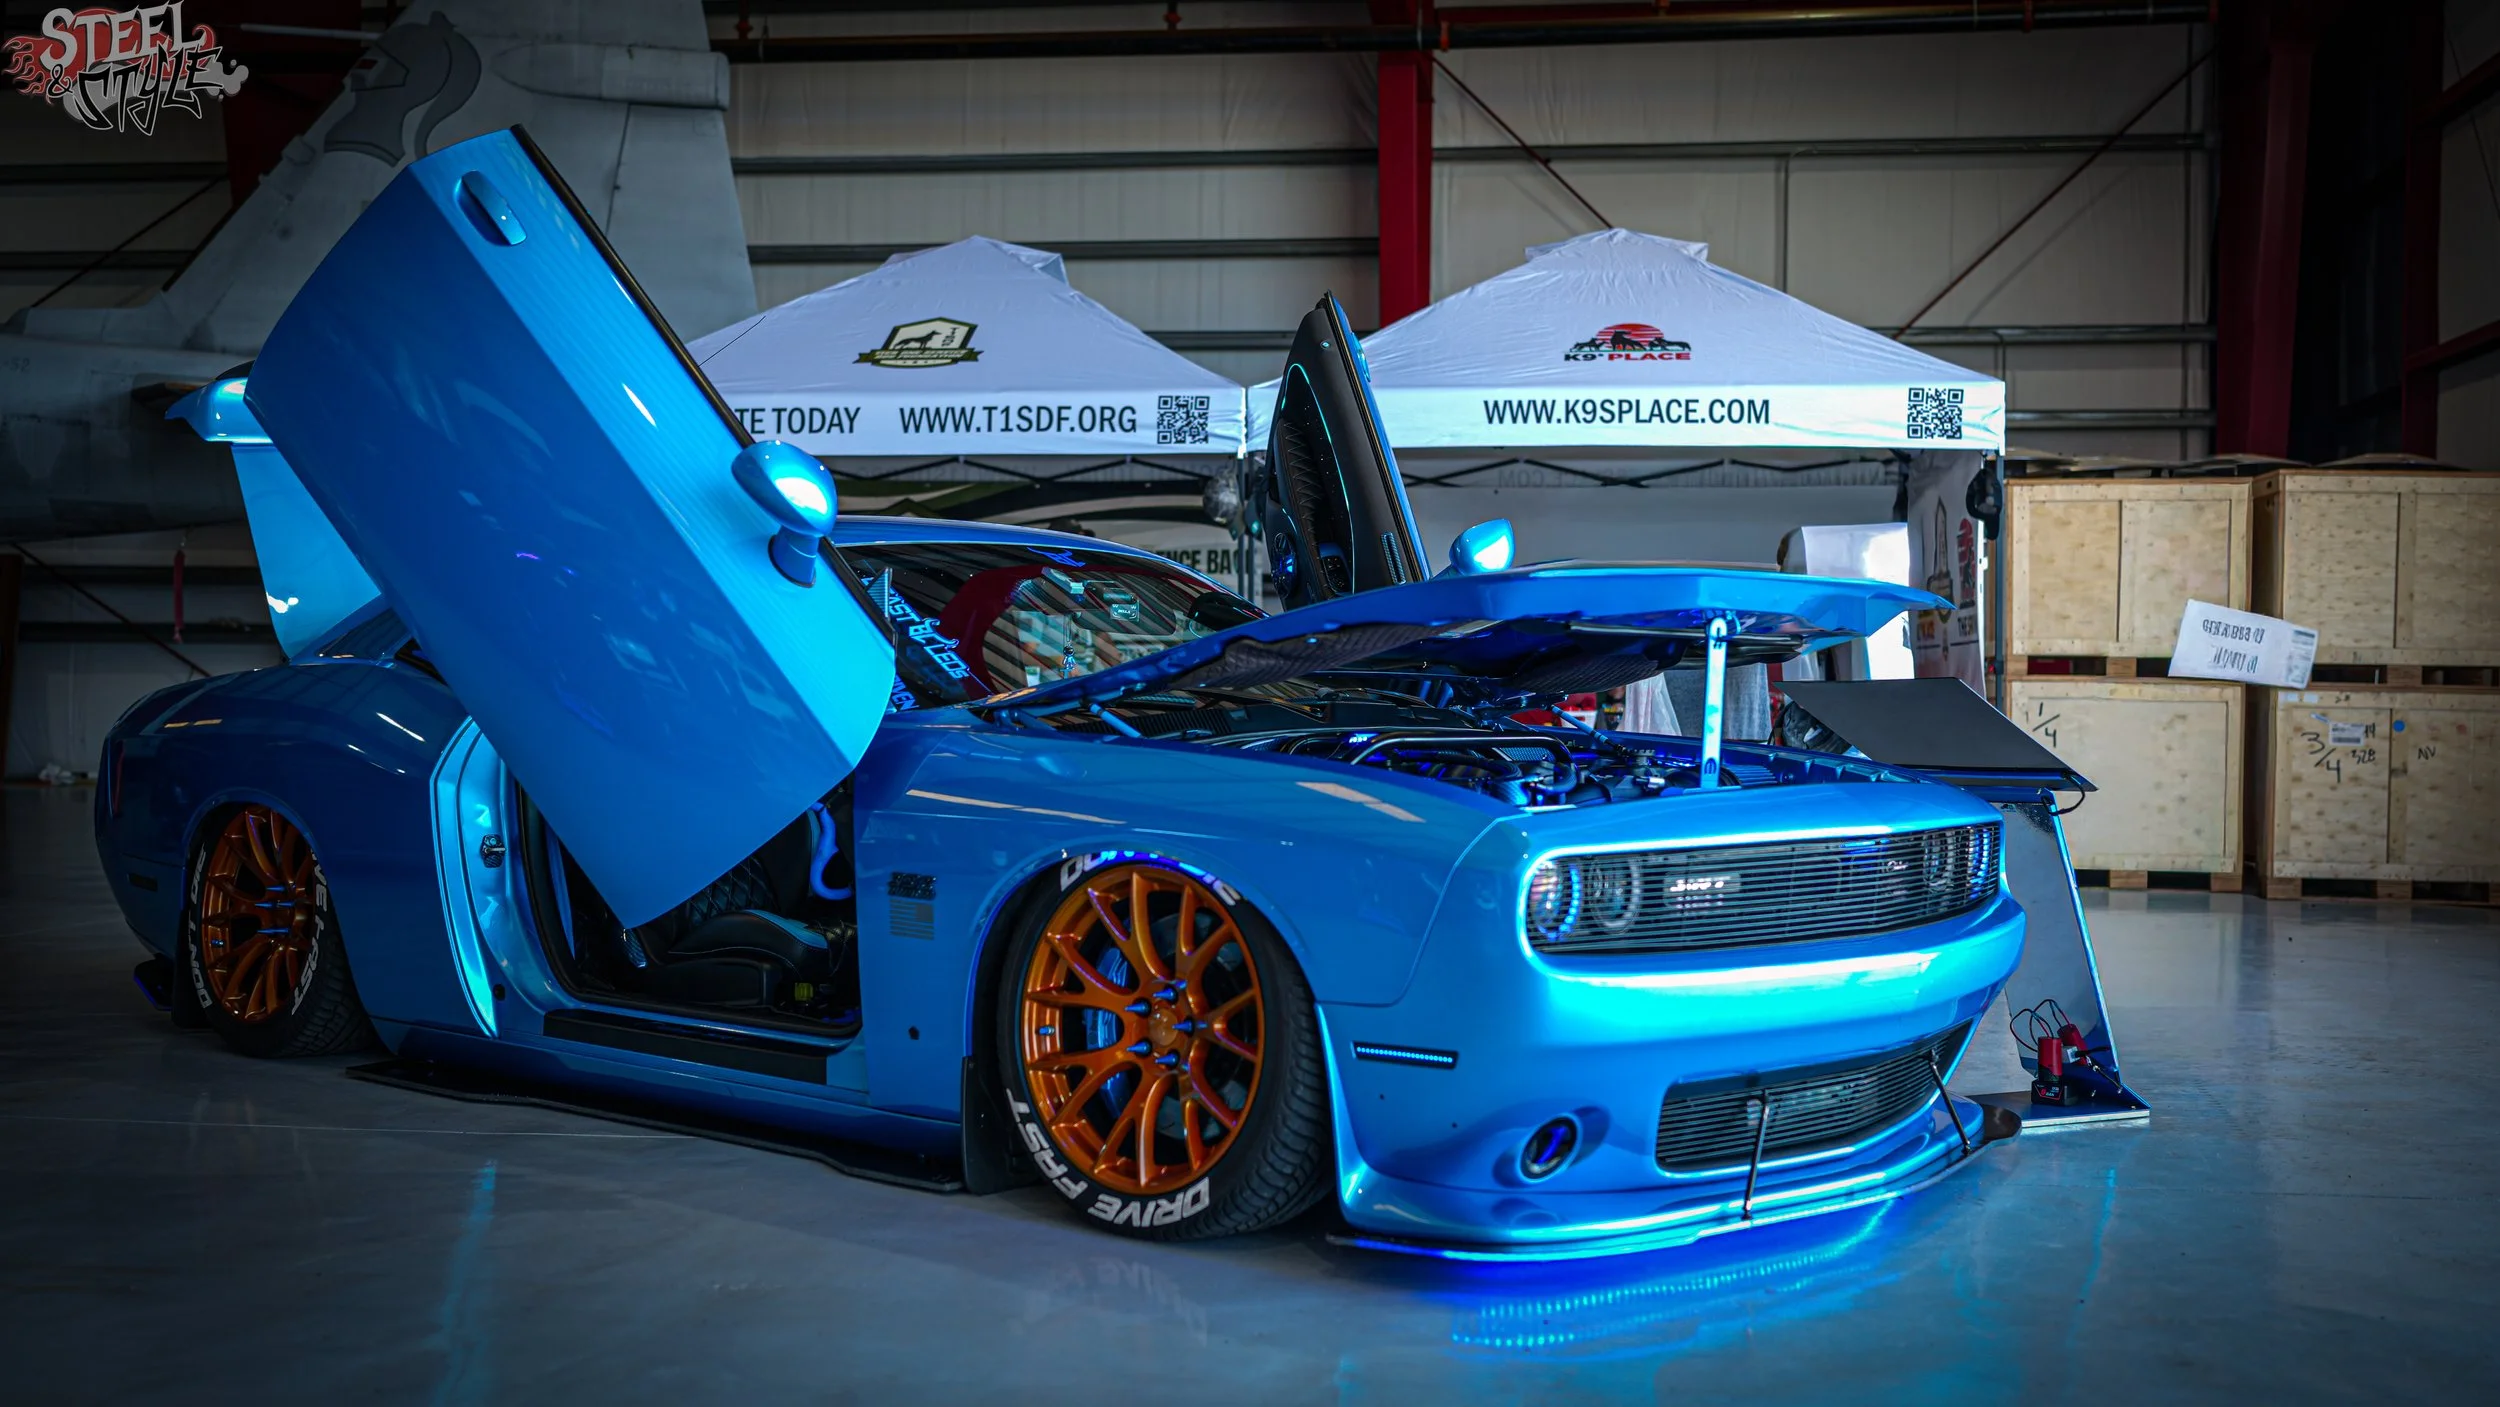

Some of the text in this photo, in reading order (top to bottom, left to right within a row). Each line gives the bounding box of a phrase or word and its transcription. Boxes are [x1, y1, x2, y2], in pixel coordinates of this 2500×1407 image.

[1608, 352, 1691, 361] PLACE
[734, 407, 861, 434] TE TODAY
[899, 404, 1138, 434] WWW.T1SDF.ORG
[1483, 398, 1770, 424] WWW.K9SPLACE.COM
[2301, 732, 2341, 783] 3/4
[1006, 1088, 1210, 1227] DRIVE FAST
